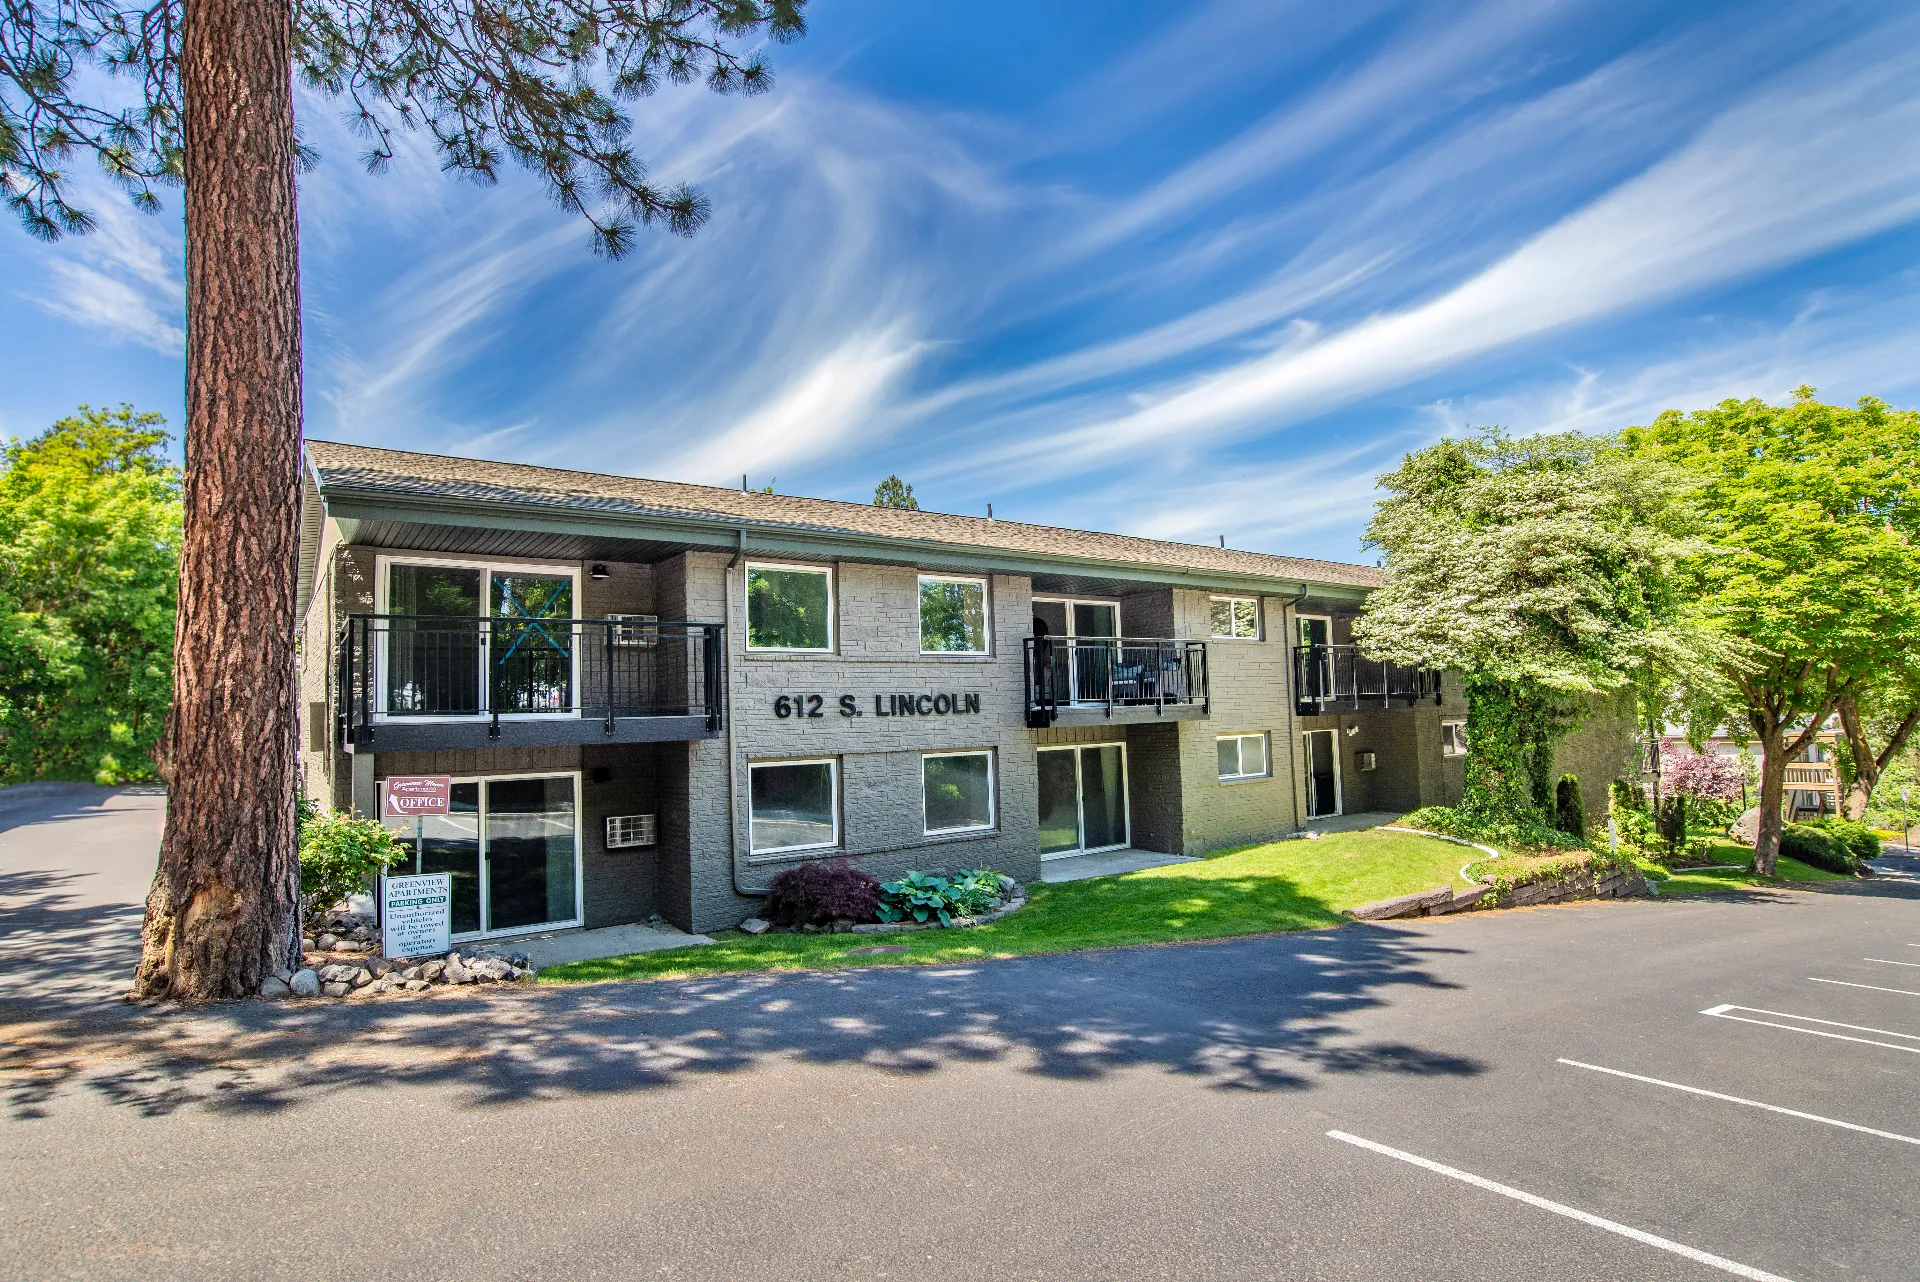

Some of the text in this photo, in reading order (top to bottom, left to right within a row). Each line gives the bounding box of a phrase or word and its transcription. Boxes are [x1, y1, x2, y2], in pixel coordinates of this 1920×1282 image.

[774, 693, 981, 718] 612 S. LINCOLN
[400, 798, 445, 807] OFFICE
[391, 878, 445, 889] GREENVIEW
[388, 886, 448, 898] APARTMENTS
[391, 896, 445, 908] PARKING ONLY
[389, 908, 445, 920] Unauthorized
[420, 920, 444, 929] towed
[407, 928, 436, 936] owners
[398, 938, 436, 948] operators
